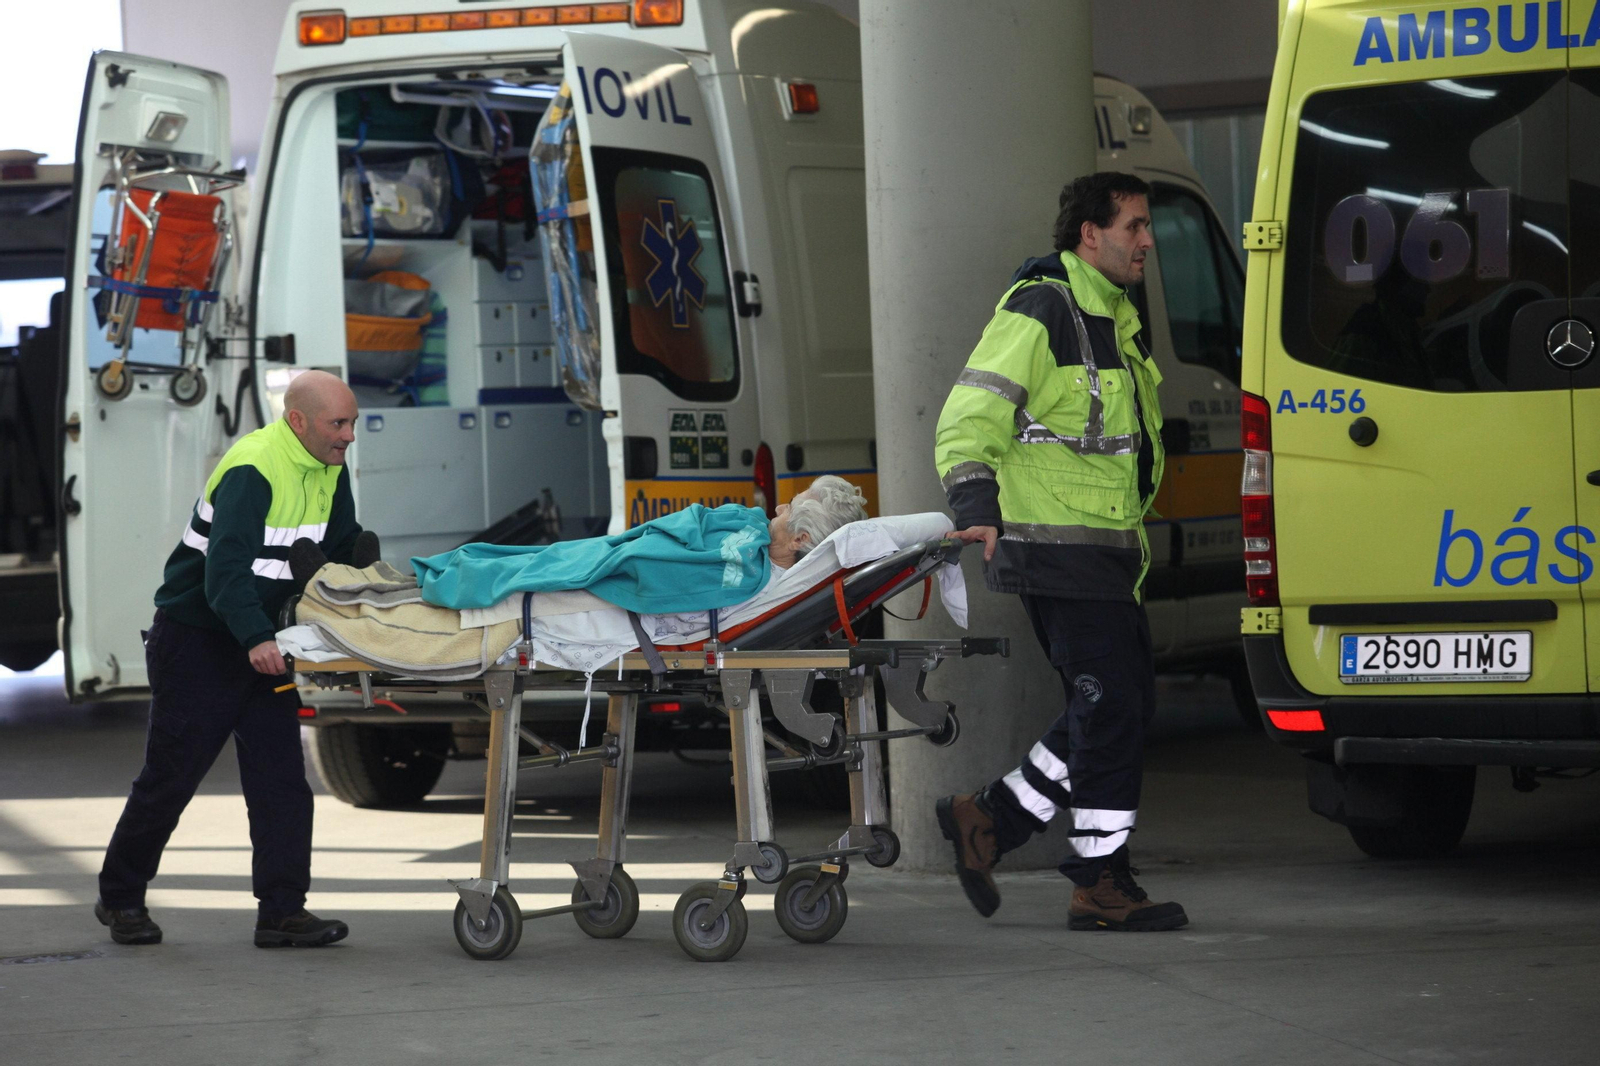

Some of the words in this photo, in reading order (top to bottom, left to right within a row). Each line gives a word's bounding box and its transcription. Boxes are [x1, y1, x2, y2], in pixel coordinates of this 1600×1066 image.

[1324, 188, 1510, 287] 061
[1276, 388, 1366, 414] A-456
[1433, 507, 1596, 588] bás
[1346, 659, 1354, 669] E
[1363, 639, 1441, 669] 2690
[1454, 638, 1517, 668] HMG
